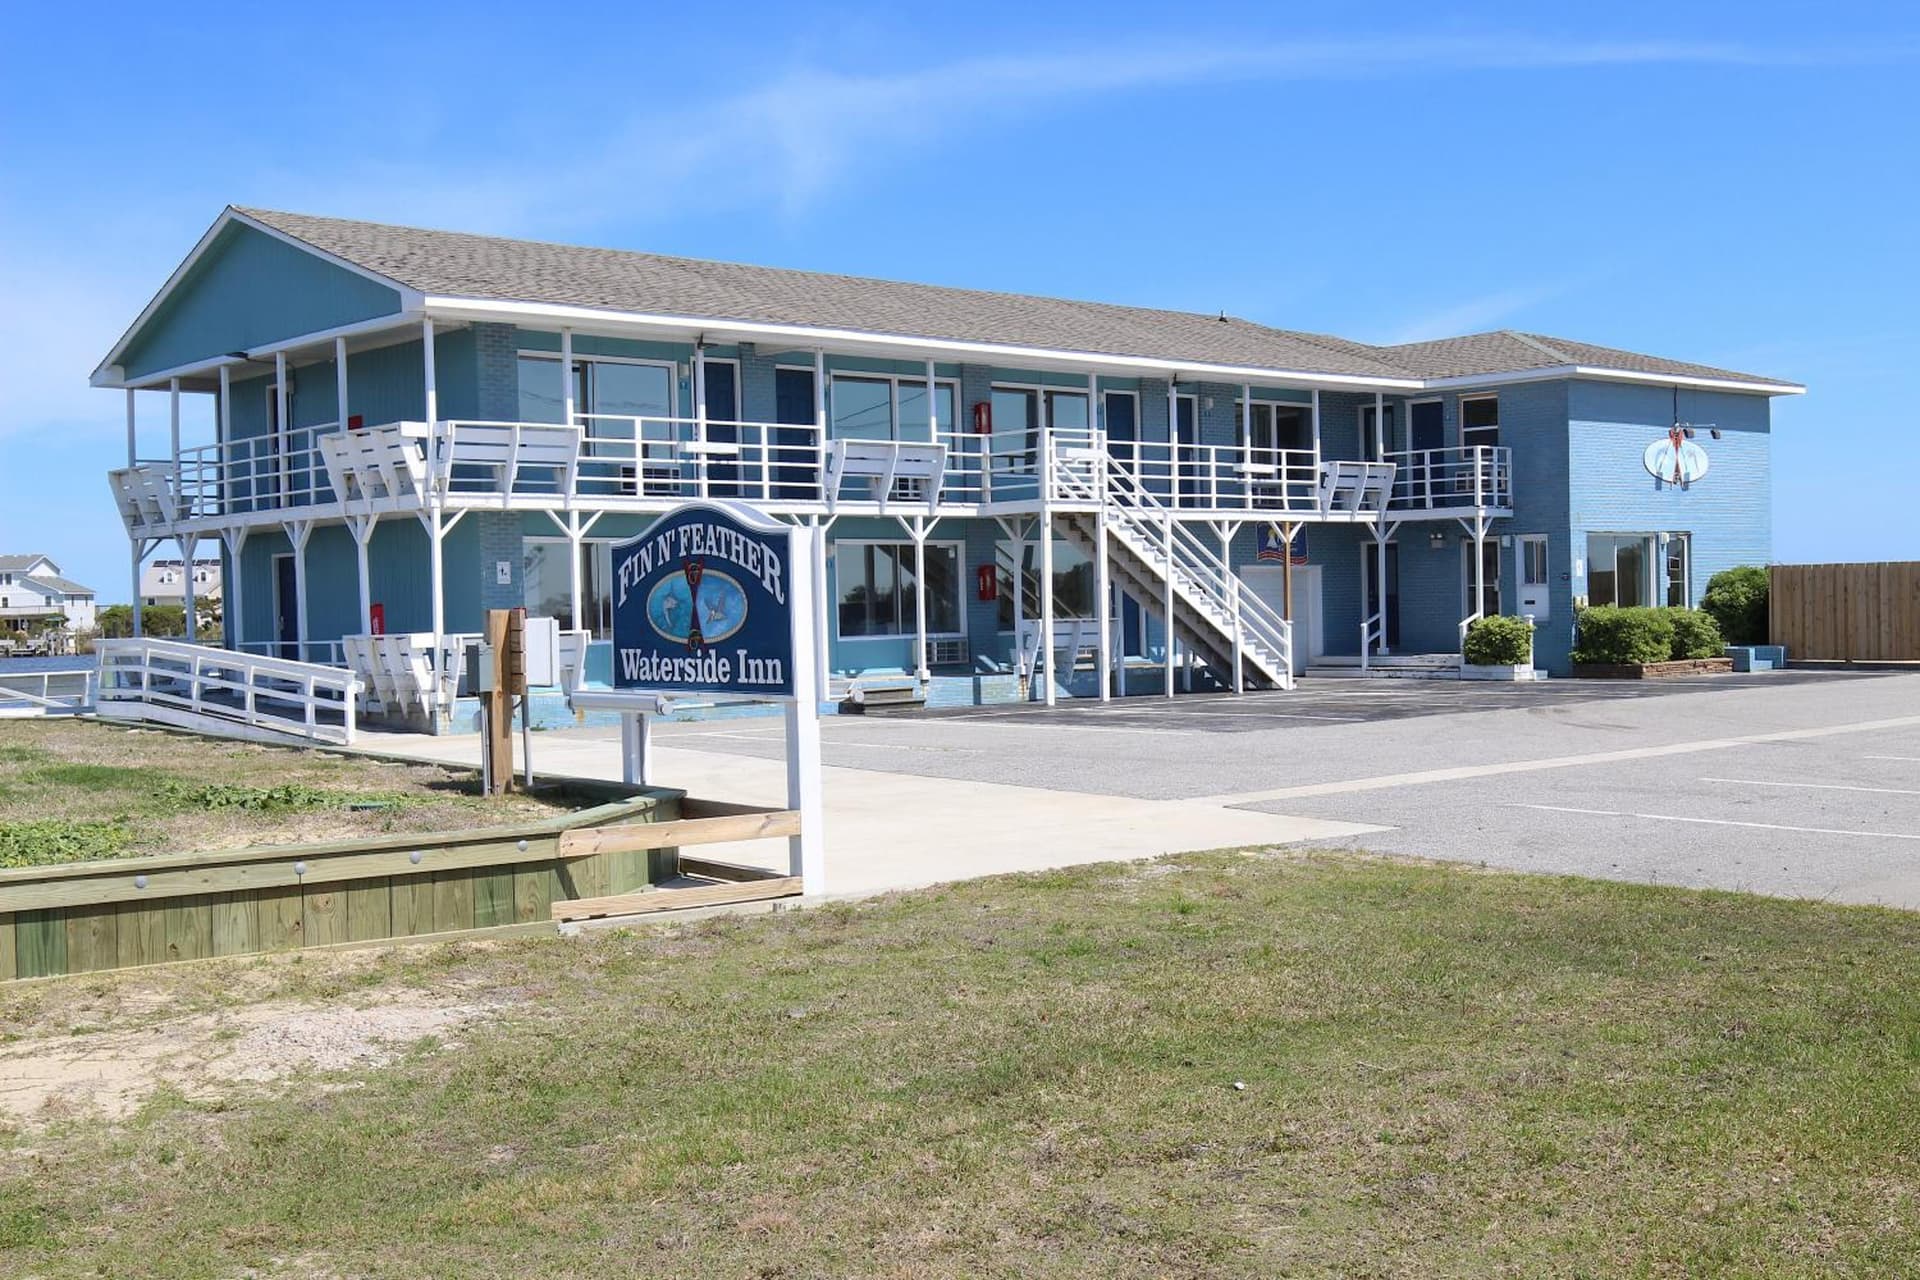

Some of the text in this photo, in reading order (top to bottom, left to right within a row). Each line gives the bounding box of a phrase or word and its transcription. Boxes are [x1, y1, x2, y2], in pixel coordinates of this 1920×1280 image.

[618, 541, 654, 608] FIN
[678, 523, 785, 605] FEATHER
[621, 648, 784, 685] Waterside Inn
